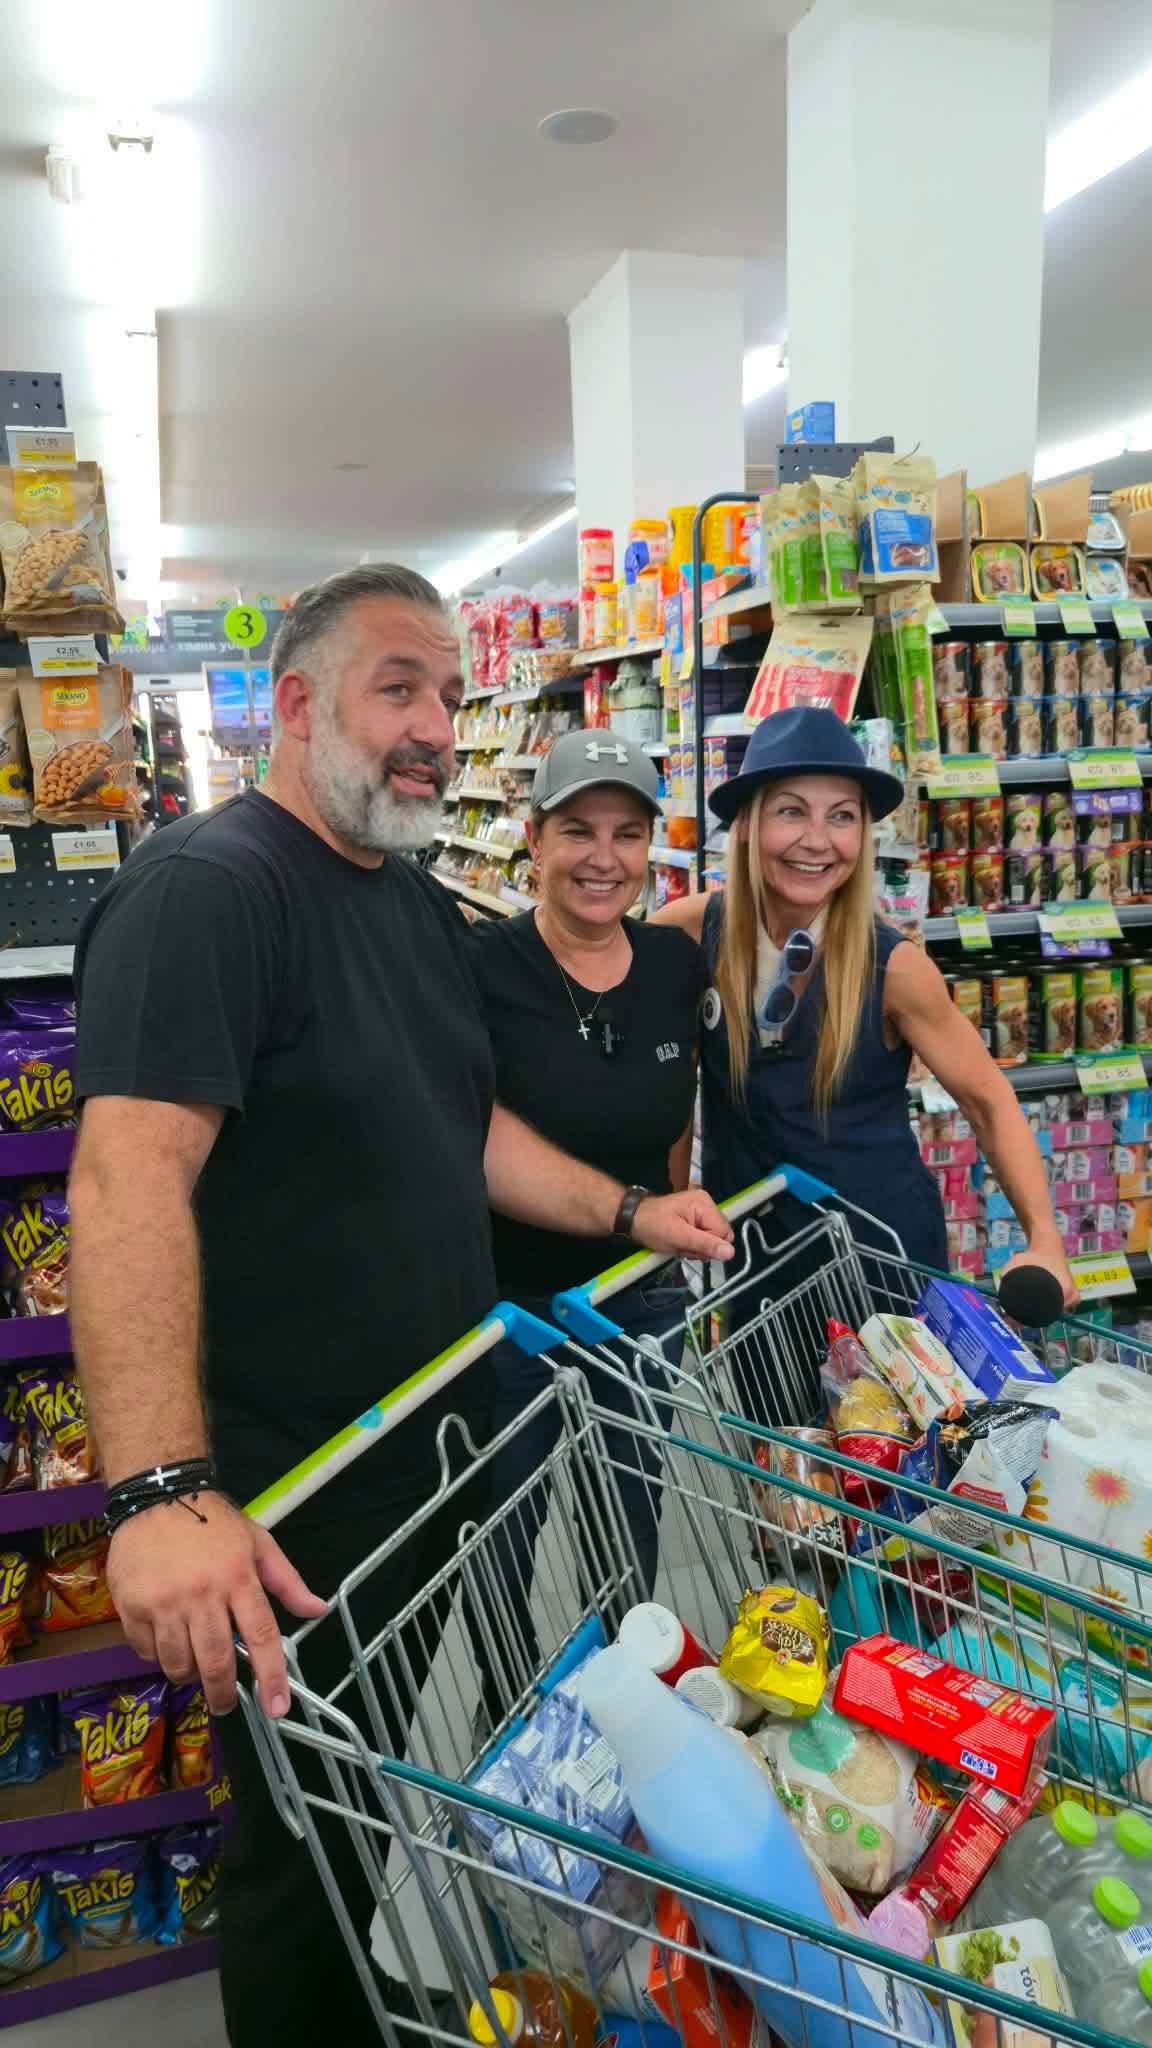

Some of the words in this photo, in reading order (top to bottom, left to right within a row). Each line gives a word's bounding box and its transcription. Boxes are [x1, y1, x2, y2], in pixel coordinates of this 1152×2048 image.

[236, 612, 254, 639] 3
[1, 1202, 70, 1271] Tak
[74, 1701, 150, 1763] Takis
[205, 1776, 232, 1812] Tak
[58, 1872, 136, 1917] Takis
